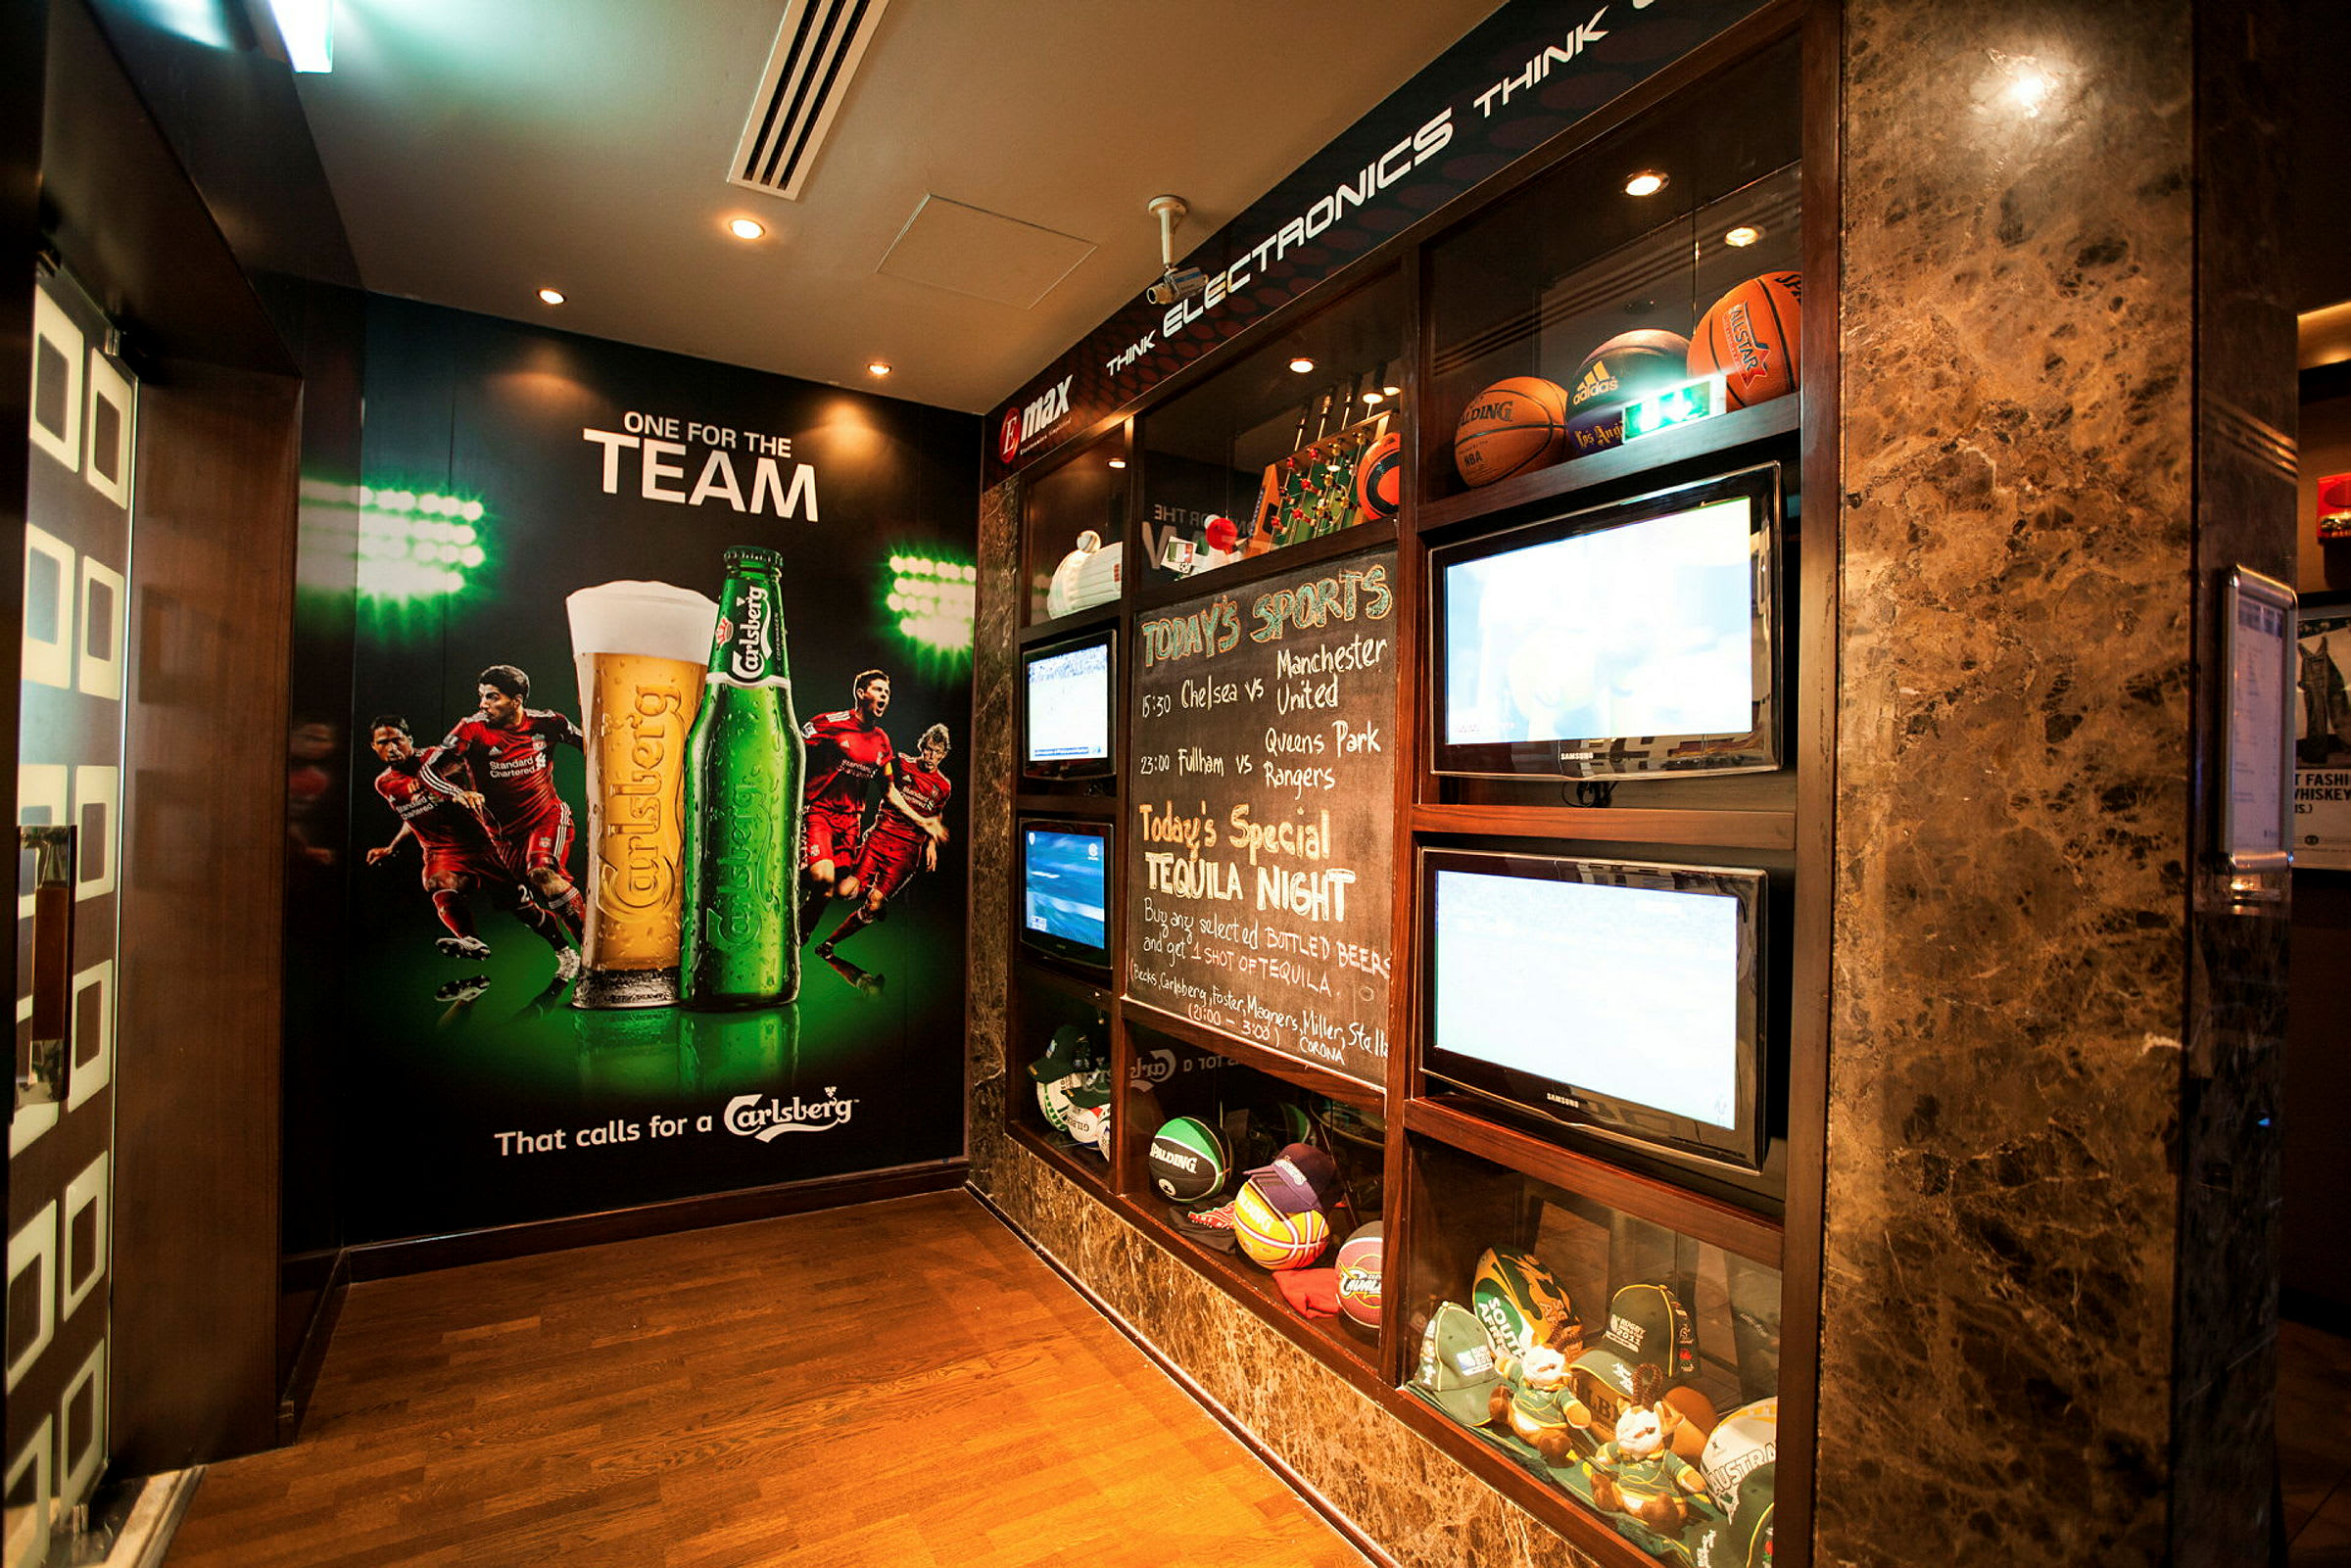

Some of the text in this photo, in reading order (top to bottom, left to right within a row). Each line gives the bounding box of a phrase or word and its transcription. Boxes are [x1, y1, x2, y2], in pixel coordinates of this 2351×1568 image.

[1106, 4, 1608, 376] THINK ELECTRONICS THINK
[1572, 377, 1619, 406] adidas
[624, 410, 792, 458] ONE FOR THE
[583, 427, 819, 523] TEAM
[732, 585, 772, 680] Carlsberg
[1141, 564, 1393, 668] TODAY'S SPORTS
[1276, 634, 1388, 681] Manchester
[1142, 693, 1172, 718] 15:30
[1181, 675, 1238, 711] Chelsea
[1276, 673, 1339, 716] United
[1265, 720, 1382, 758] Queens Park
[1560, 751, 1594, 761] SAMSUNG
[489, 756, 534, 772] Standard
[490, 767, 536, 780] Chartered
[1140, 754, 1171, 776] 23:00
[1263, 760, 1336, 801] Rangers
[2306, 773, 2351, 786] FASHI
[596, 684, 686, 925] Carlsberg
[1139, 800, 1330, 866] Today's Special
[706, 780, 781, 951] Carlsberg
[1144, 852, 1357, 923] TEQUILA NIGHT
[1144, 897, 1169, 938] Buy
[1170, 911, 1194, 945] any
[1200, 914, 1259, 950] selected
[1265, 927, 1330, 961] BOTTLED
[1143, 934, 1163, 953] and
[1167, 938, 1185, 968] get
[1191, 942, 1202, 960] 1
[1205, 946, 1234, 972] SHOT
[1238, 956, 1258, 974] OF
[1299, 1035, 1346, 1067] CORONA
[494, 1087, 855, 1157] That calls for a Carlsberg
[1149, 1141, 1198, 1174] SPALDING
[1708, 1442, 1777, 1496] AUSTRA
